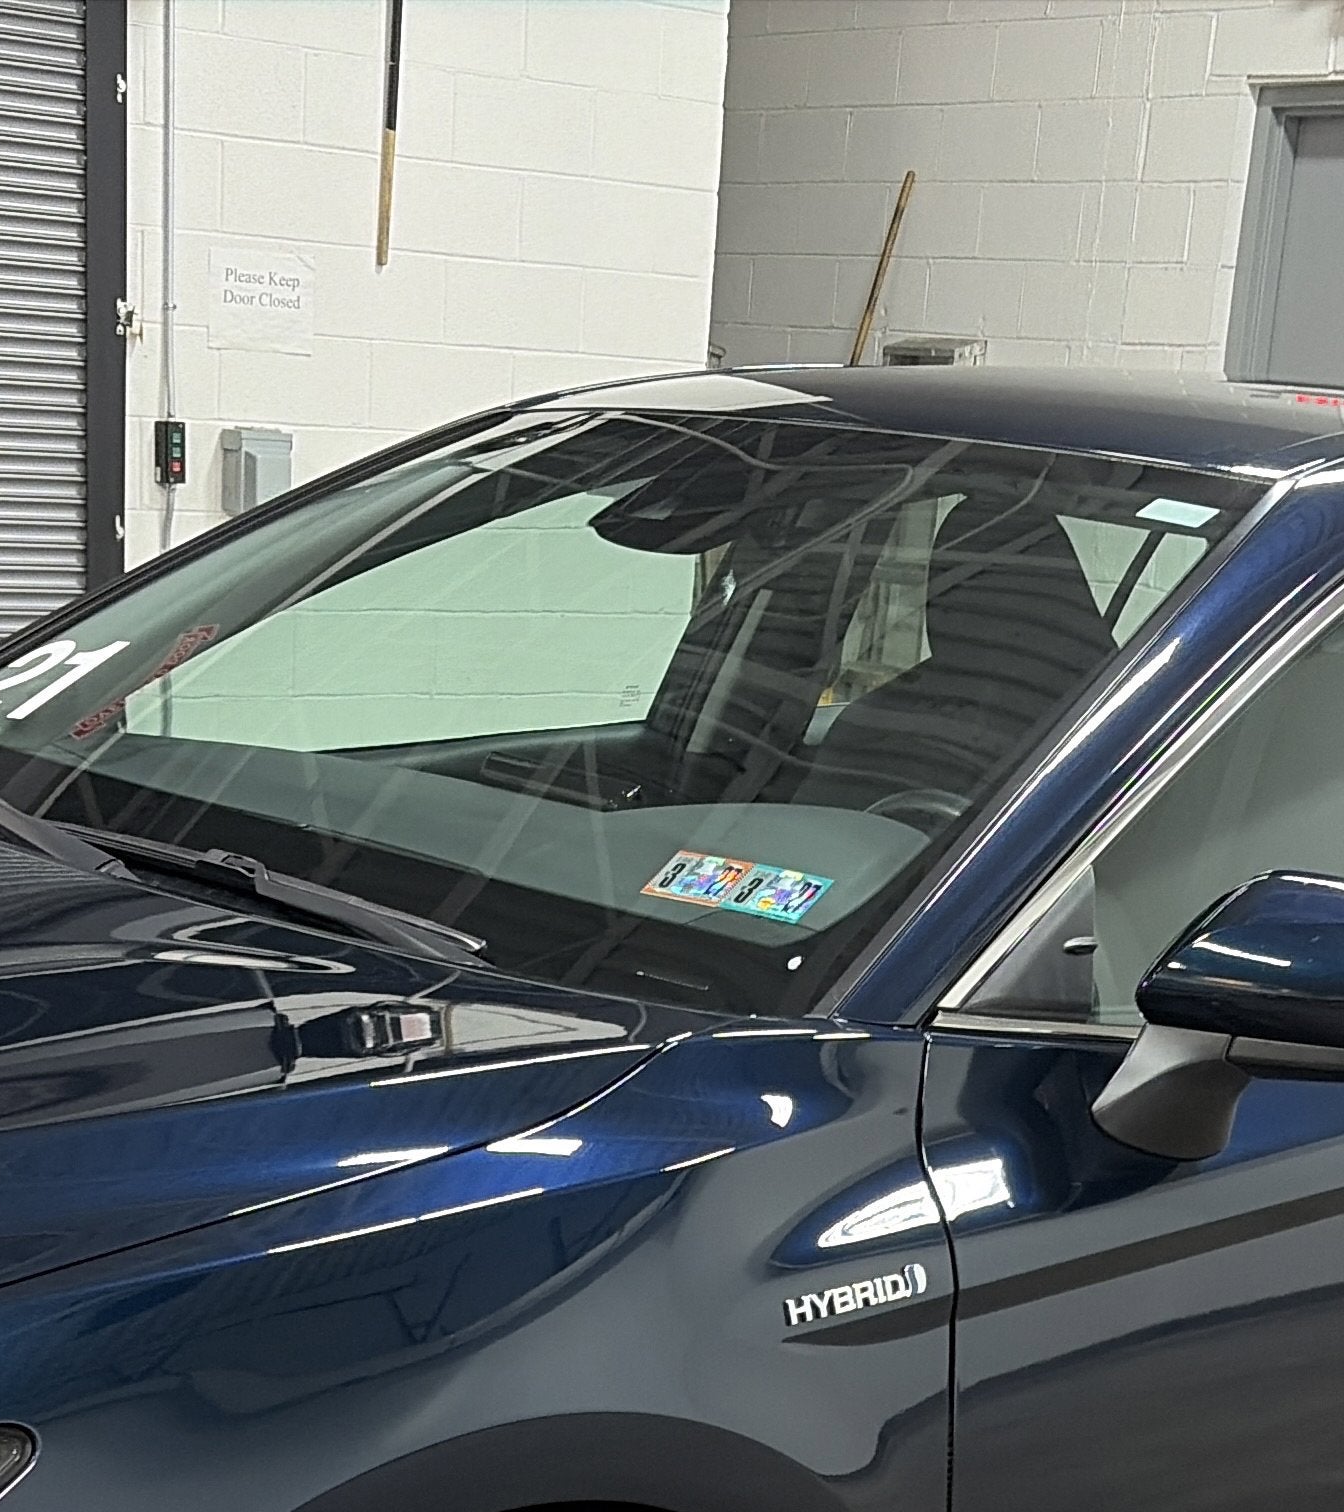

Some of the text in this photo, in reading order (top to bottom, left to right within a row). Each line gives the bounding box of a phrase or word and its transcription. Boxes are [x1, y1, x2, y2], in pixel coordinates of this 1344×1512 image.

[224, 267, 300, 291] Please Keep
[223, 289, 301, 310] Door Closed
[658, 863, 687, 888] 3
[734, 877, 764, 903] 3
[785, 1273, 909, 1326] HYBRID
